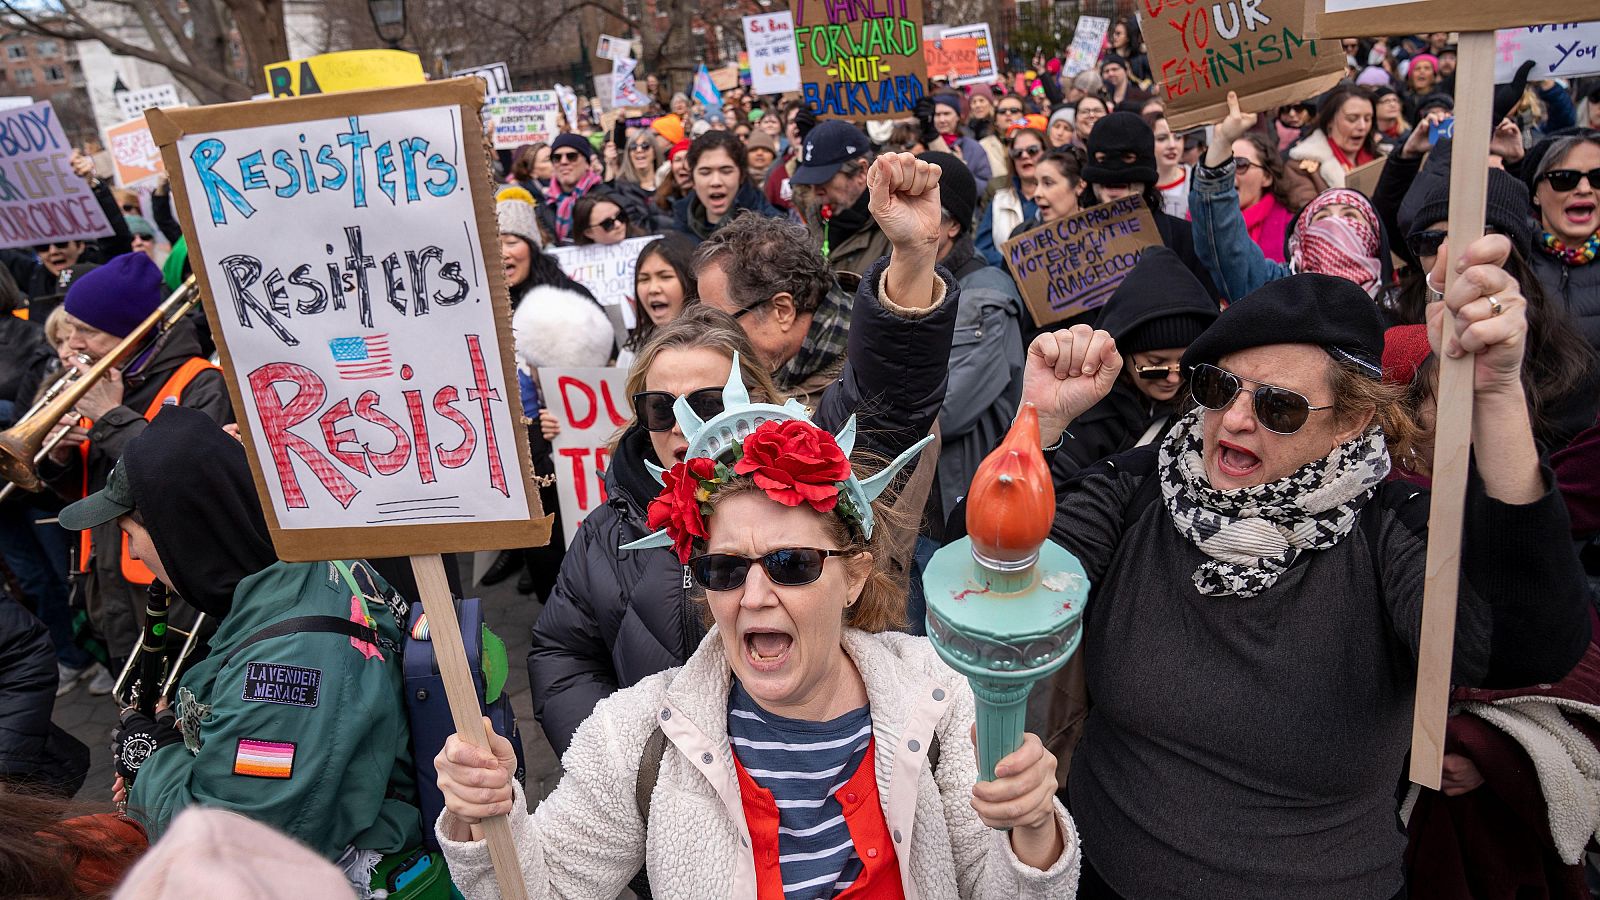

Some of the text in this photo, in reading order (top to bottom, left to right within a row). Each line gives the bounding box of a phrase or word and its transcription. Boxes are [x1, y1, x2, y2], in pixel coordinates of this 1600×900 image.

[795, 17, 919, 67] FORWARD
[1168, 0, 1272, 53] YOUR
[1549, 41, 1598, 72] You
[499, 96, 518, 104] MEN
[519, 94, 550, 103] COULD
[508, 104, 556, 113] PREGNANT
[803, 73, 924, 116] BACKWARD
[0, 106, 60, 156] BODY
[496, 125, 525, 133] WOULD
[527, 124, 537, 132] BE
[501, 114, 545, 123] ABORTION
[496, 133, 549, 144] SACRAMENT
[14, 154, 80, 199] LIFE
[1010, 196, 1141, 265] NEVER COMPROMISE
[1017, 255, 1048, 279] NOT
[1047, 239, 1085, 263] EVEN
[1104, 218, 1141, 239] THE
[1046, 245, 1106, 280] FACE OF
[616, 258, 636, 278] US
[249, 665, 317, 687] LAVENDER
[254, 682, 309, 702] MENACE
